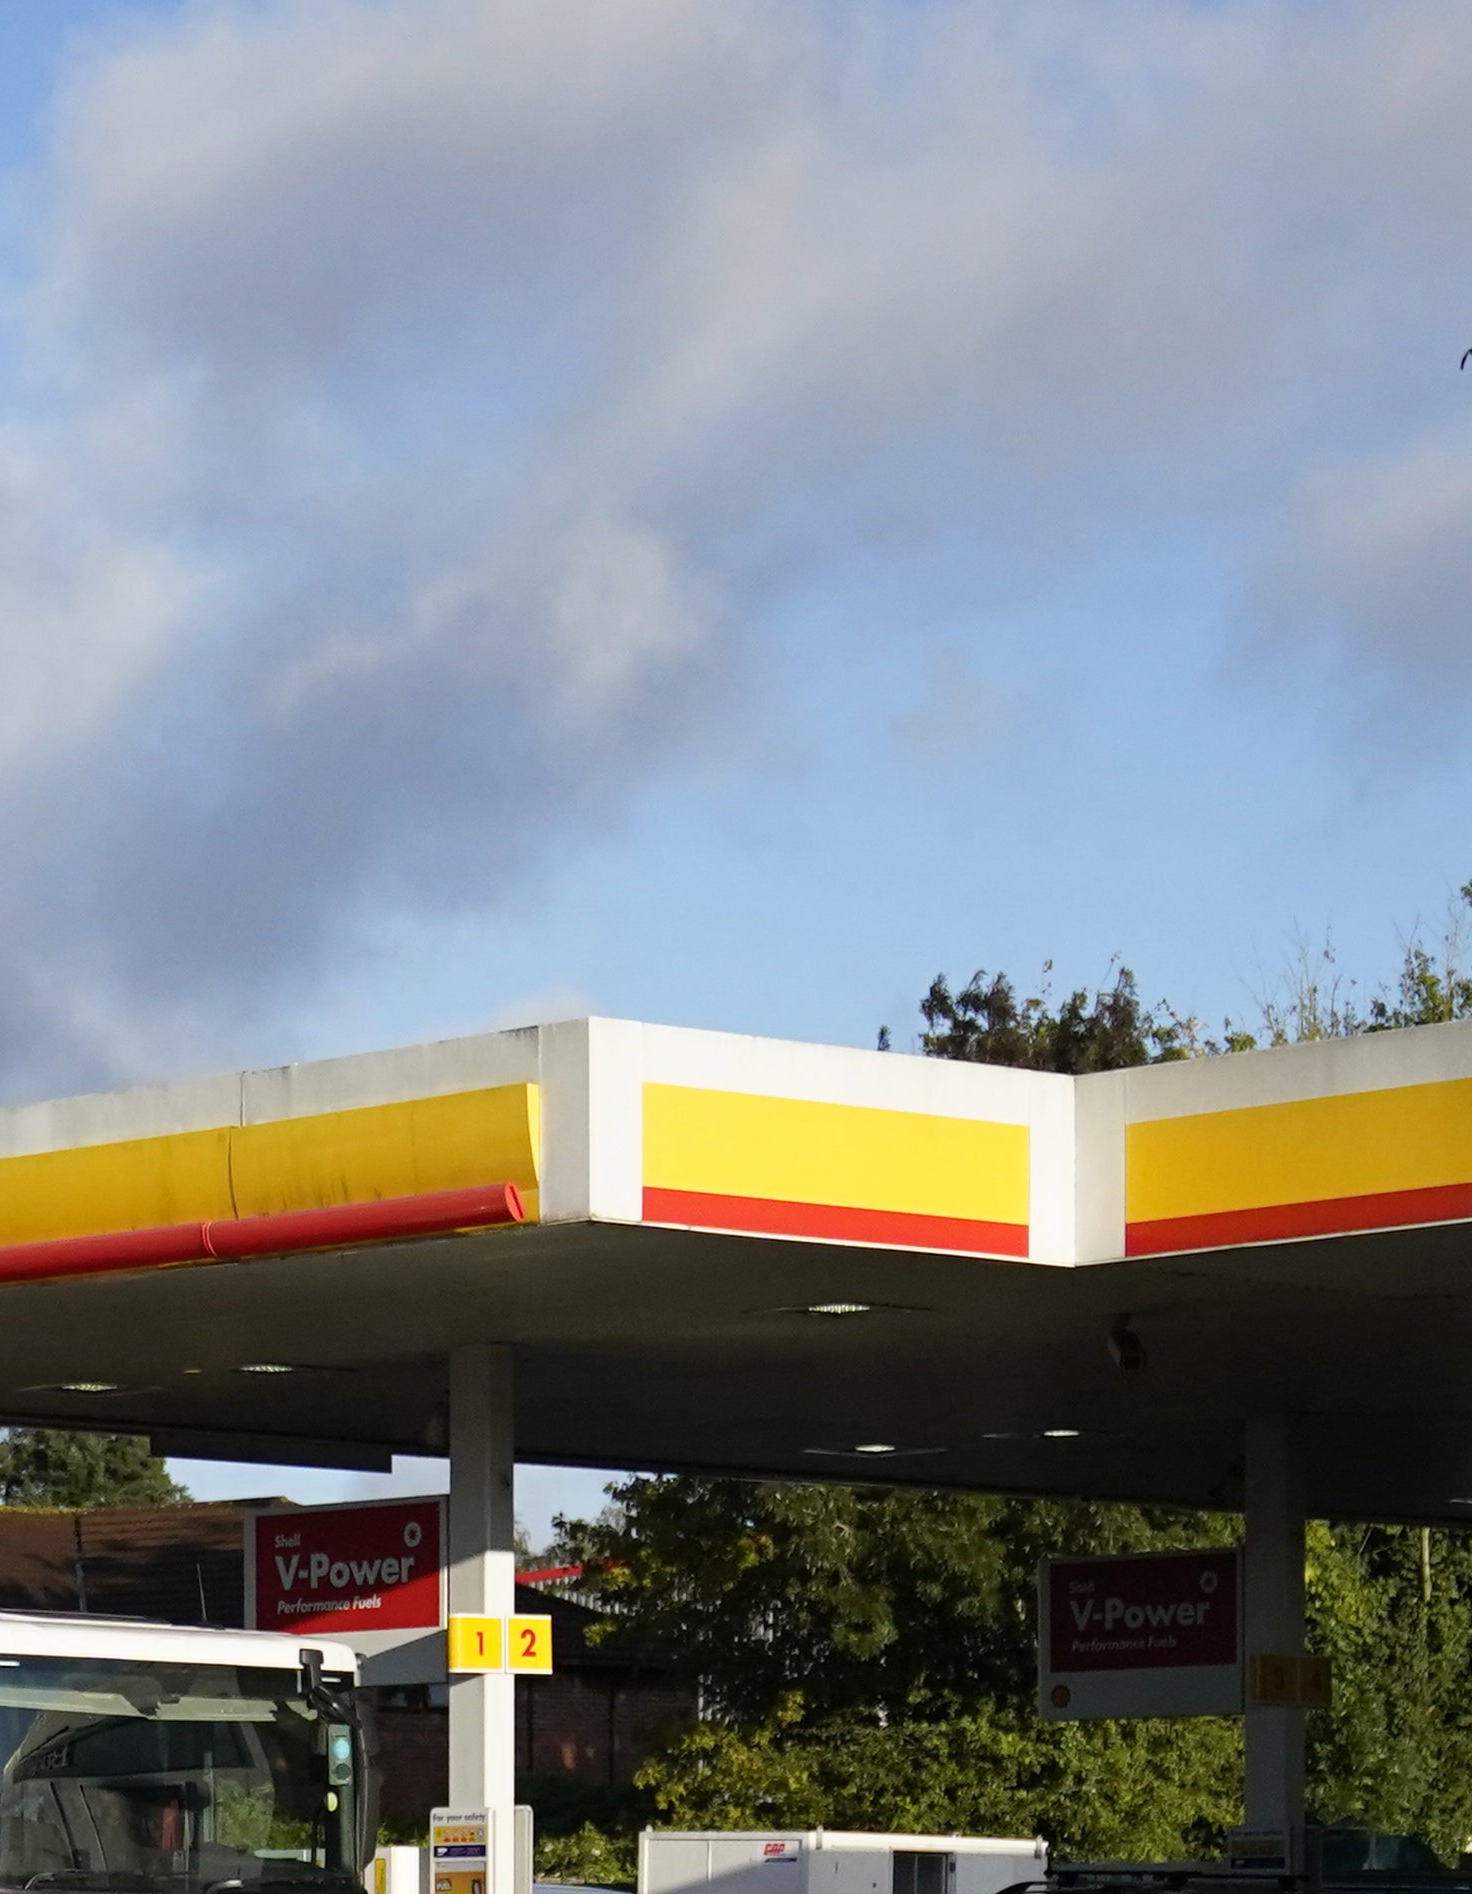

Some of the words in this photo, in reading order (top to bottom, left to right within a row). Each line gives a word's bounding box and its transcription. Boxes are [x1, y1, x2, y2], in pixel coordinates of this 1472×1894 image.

[274, 1532, 301, 1549] Shell
[274, 1553, 415, 1592] V-Power
[276, 1598, 350, 1615] Performance
[352, 1594, 382, 1610] Fuels
[1069, 1597, 1211, 1632] V-Power
[476, 1631, 484, 1657] 1
[520, 1628, 537, 1658] 2
[1070, 1638, 1145, 1653] Performance
[1147, 1634, 1177, 1649] Fuels
[433, 1814, 445, 1822] For
[464, 1813, 487, 1823] safety
